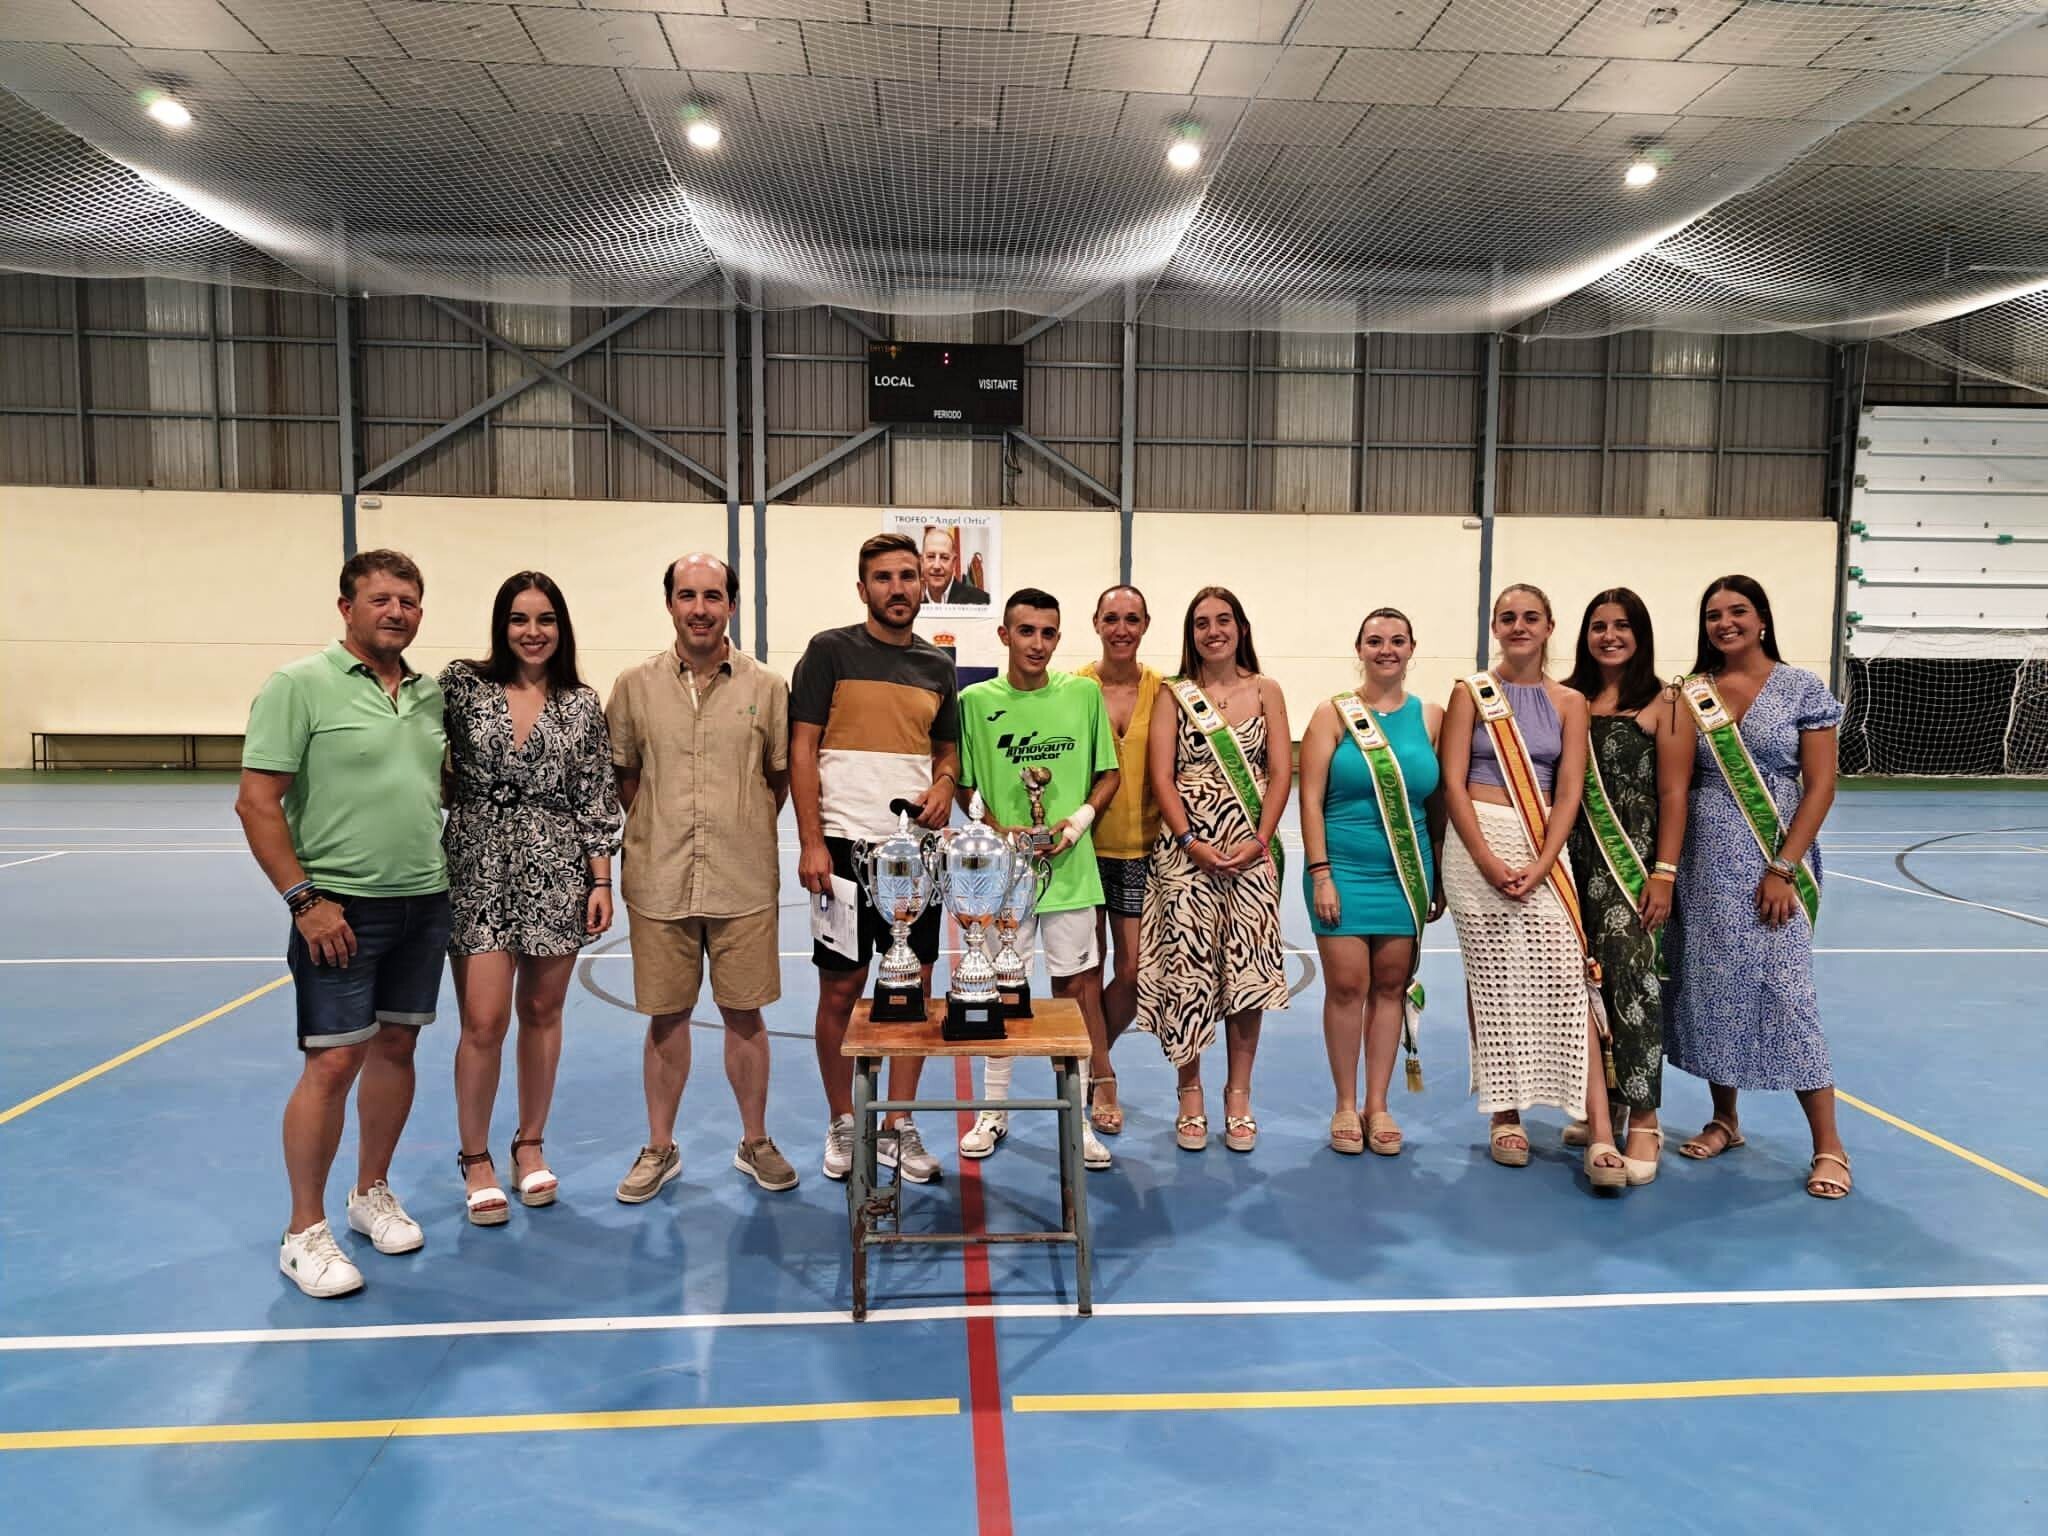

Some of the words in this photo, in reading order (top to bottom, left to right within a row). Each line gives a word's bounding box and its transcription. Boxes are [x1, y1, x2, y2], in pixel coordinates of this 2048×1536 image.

[874, 376, 915, 388] LOCAL
[978, 379, 1019, 391] VISITANTE
[933, 410, 962, 420] PERIODO
[895, 515, 928, 523] TROFEO
[1021, 752, 1061, 762] motor
[1380, 771, 1399, 822] Dama
